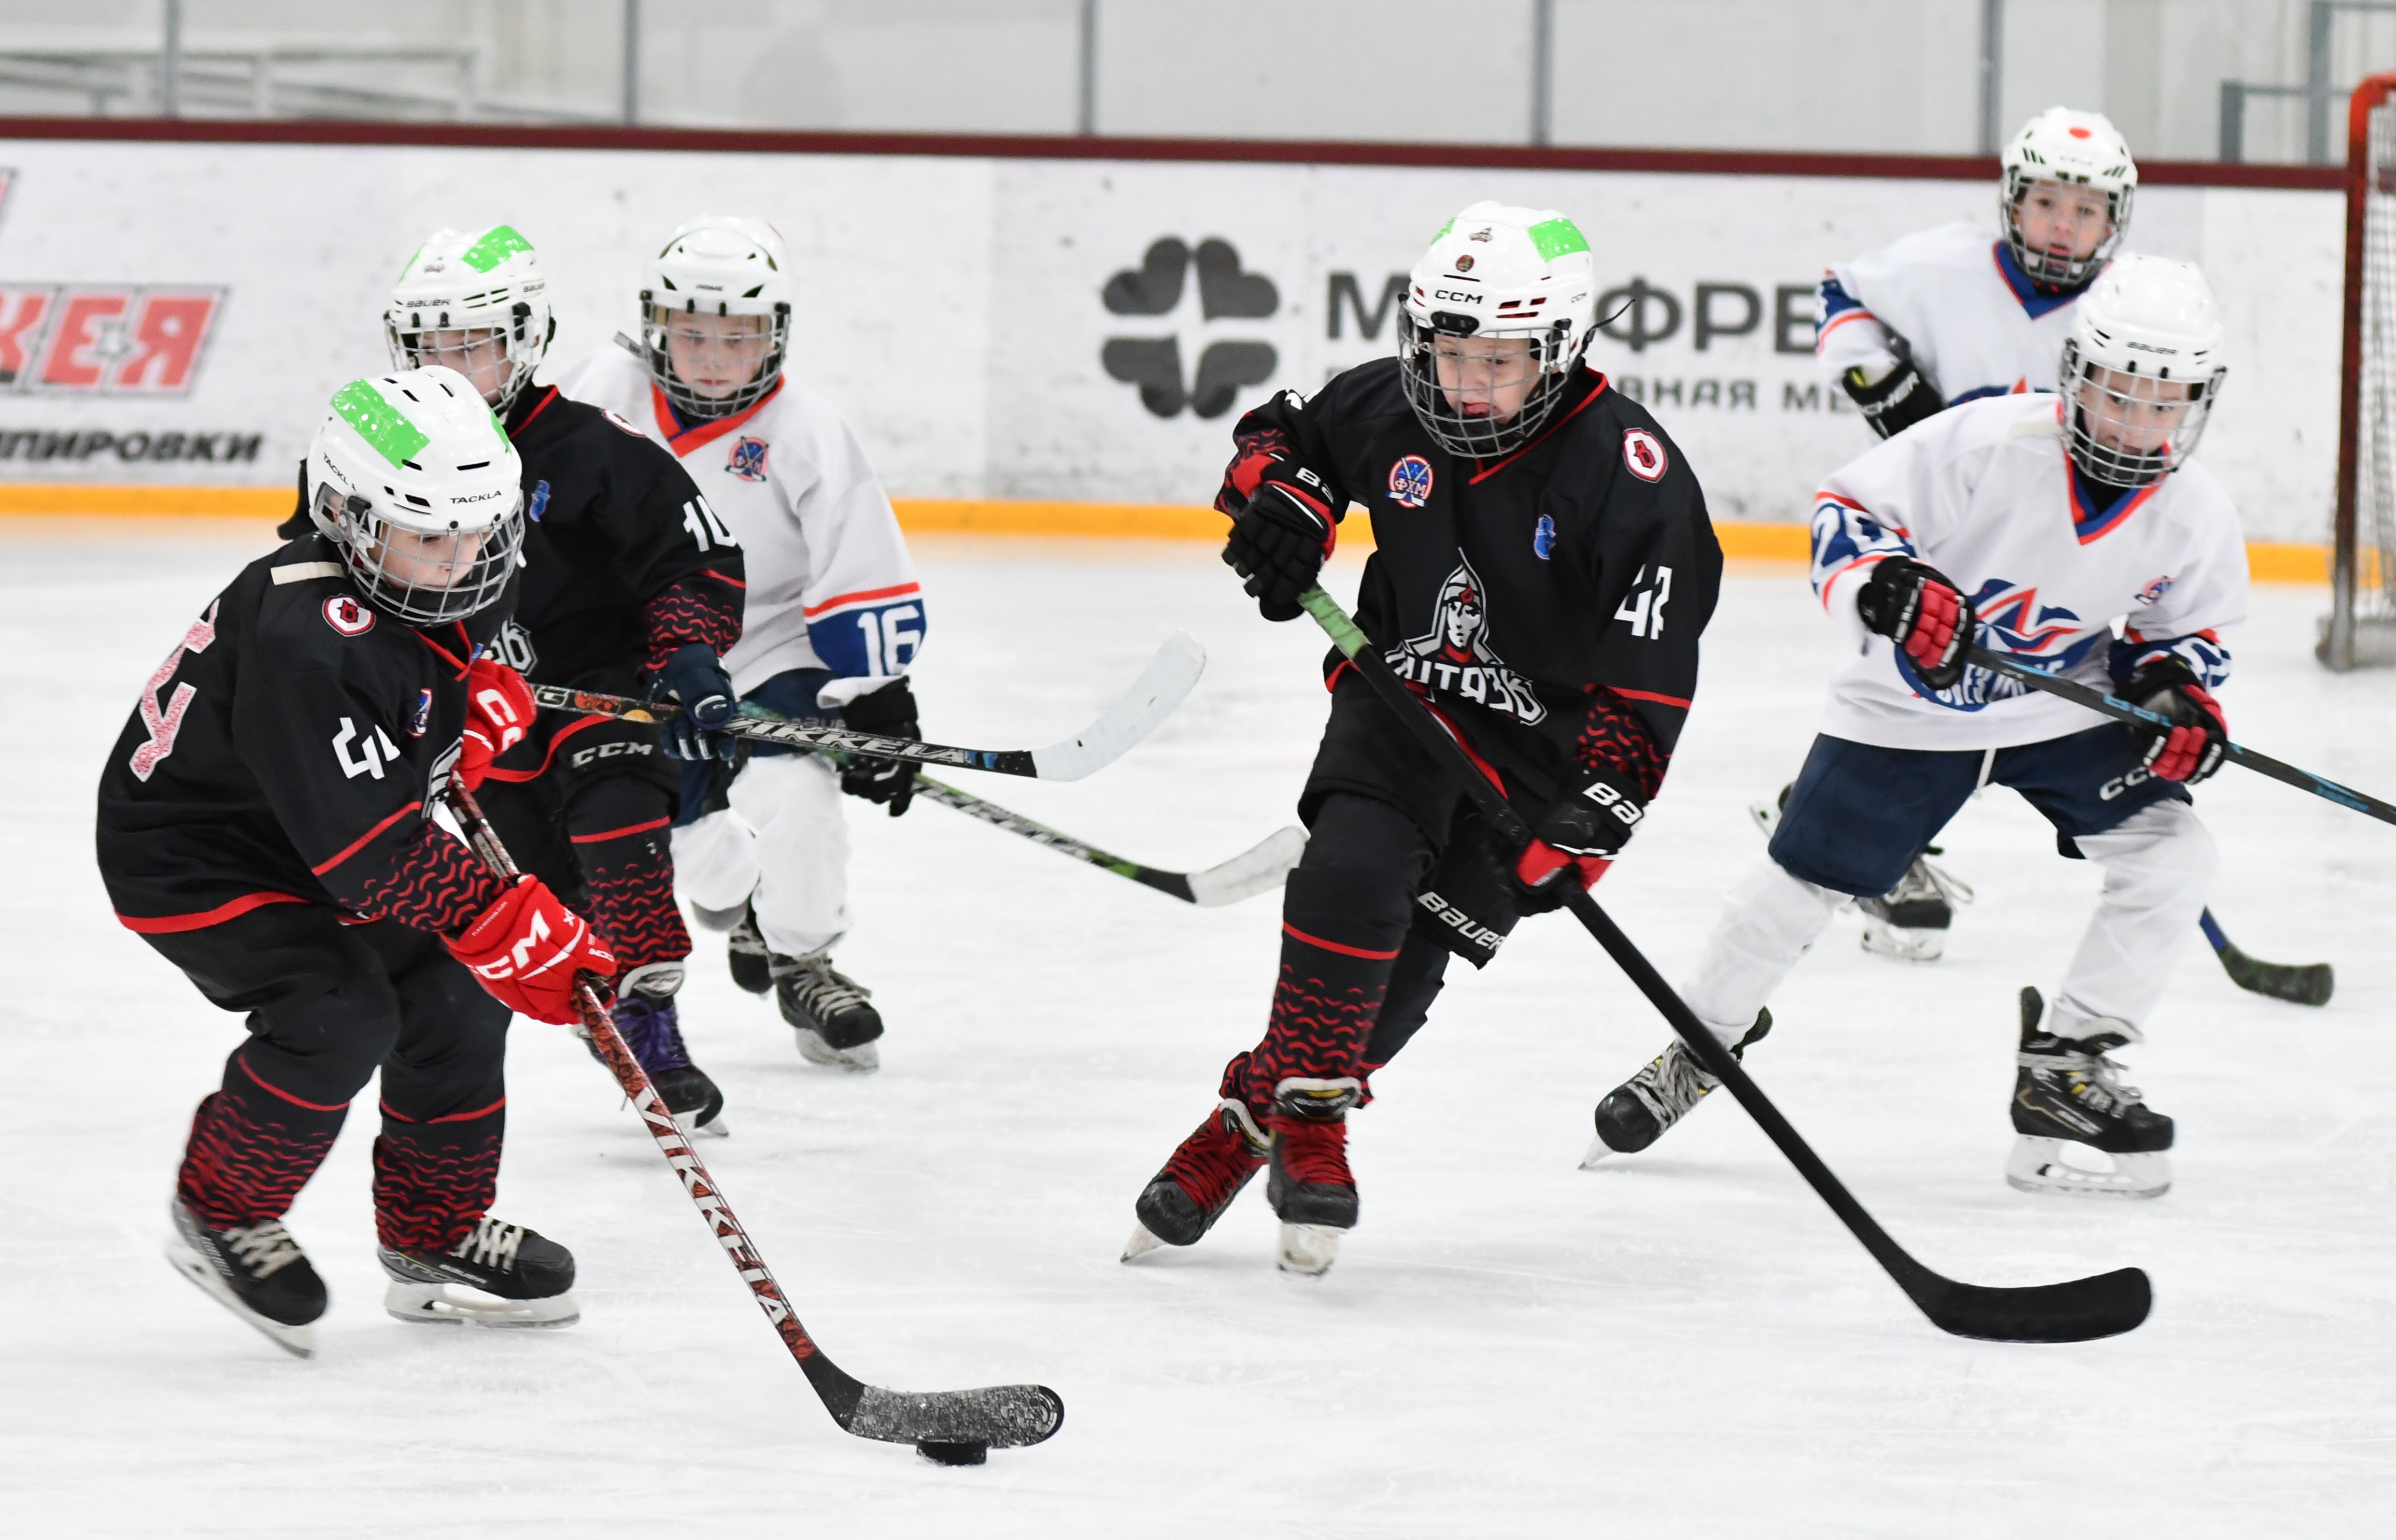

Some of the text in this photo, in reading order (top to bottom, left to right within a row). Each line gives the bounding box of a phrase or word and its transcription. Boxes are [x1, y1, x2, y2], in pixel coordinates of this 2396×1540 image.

[406, 299, 451, 307] BAUER
[1435, 290, 1484, 304] CCM
[449, 490, 502, 504] TACKLA
[857, 604, 920, 677] 16
[571, 742, 653, 768] CCM
[2100, 766, 2158, 801] CC
[1417, 891, 1506, 951] BAUER
[466, 909, 551, 980] CM
[635, 1086, 789, 1327] VIKKELA
